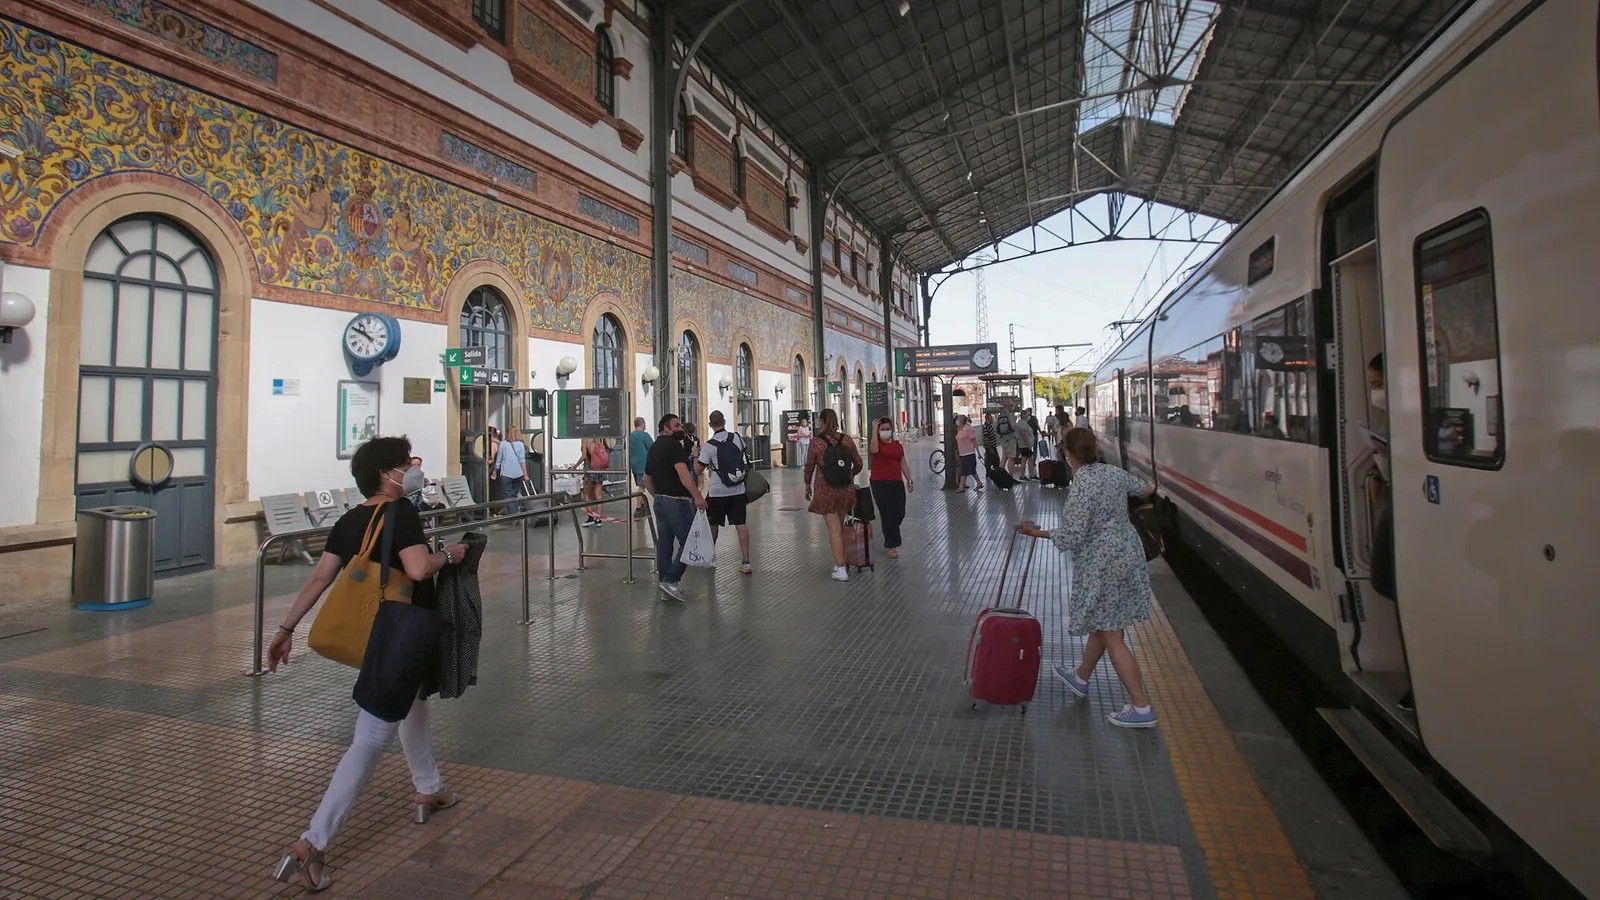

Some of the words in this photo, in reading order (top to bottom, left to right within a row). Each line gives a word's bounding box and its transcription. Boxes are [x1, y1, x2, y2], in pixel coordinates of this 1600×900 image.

[464, 350, 482, 358] Salida
[904, 361, 912, 372] 4
[473, 370, 487, 378] Salida
